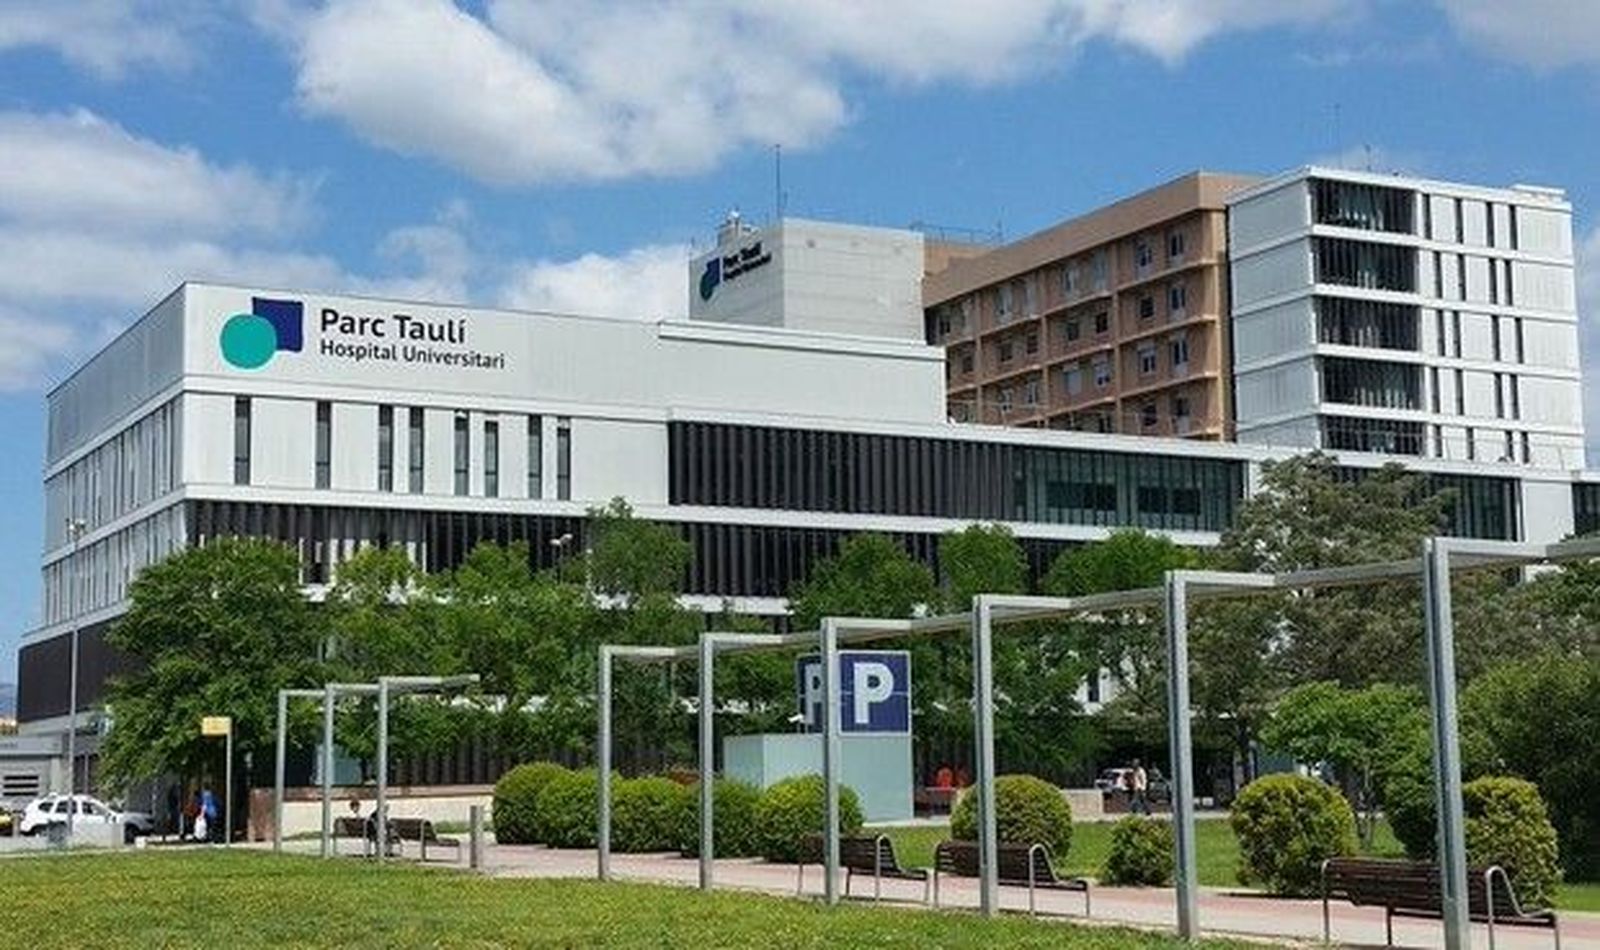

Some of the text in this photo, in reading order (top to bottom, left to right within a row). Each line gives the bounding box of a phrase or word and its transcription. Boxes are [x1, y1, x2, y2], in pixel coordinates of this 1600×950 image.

[320, 308, 466, 344] Parc Taulí
[320, 340, 505, 370] Hospital Universitari
[853, 661, 895, 724] P
